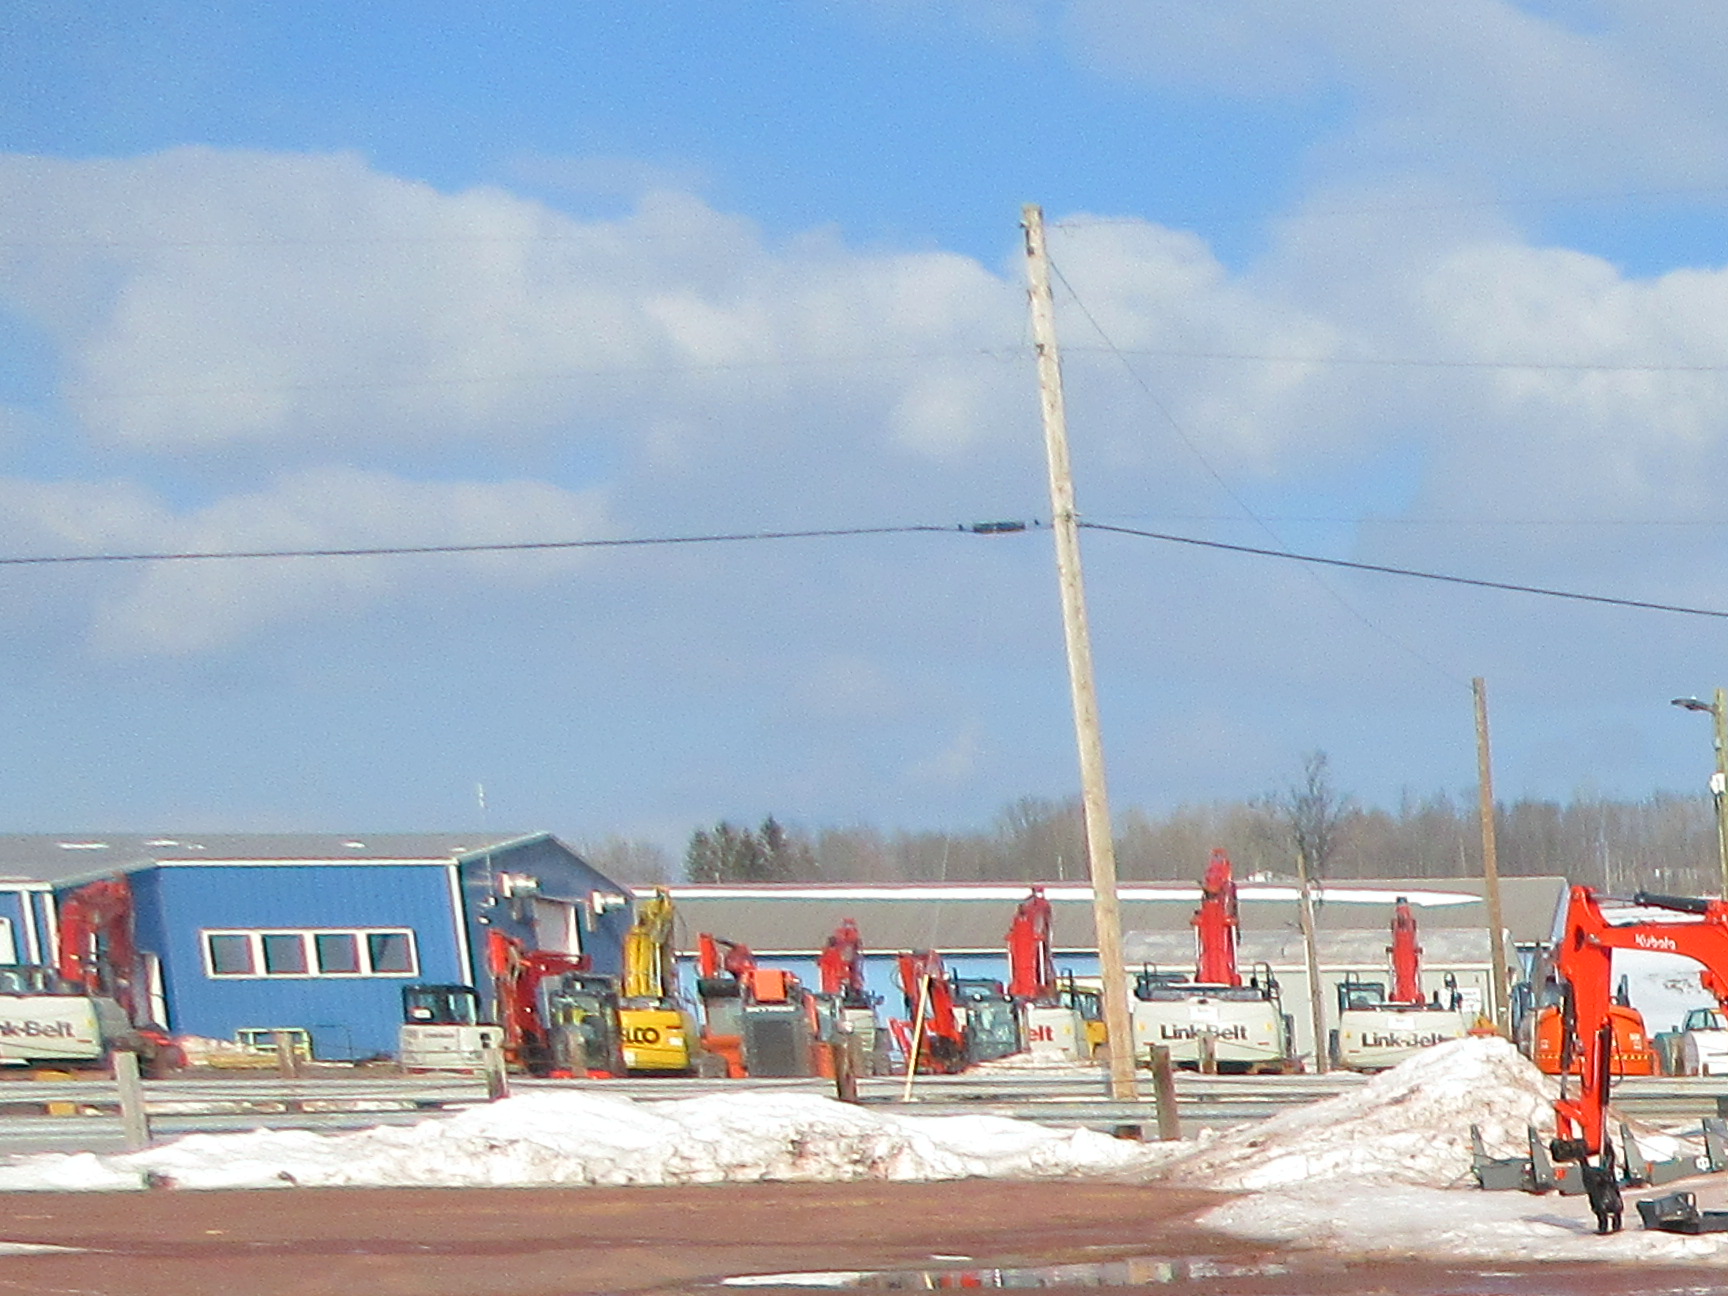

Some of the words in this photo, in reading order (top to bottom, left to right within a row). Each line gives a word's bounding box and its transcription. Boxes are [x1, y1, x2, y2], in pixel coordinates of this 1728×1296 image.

[1634, 933, 1677, 950] Kubota
[1028, 1024, 1055, 1041] elt
[1160, 1024, 1248, 1040] LinkBelt
